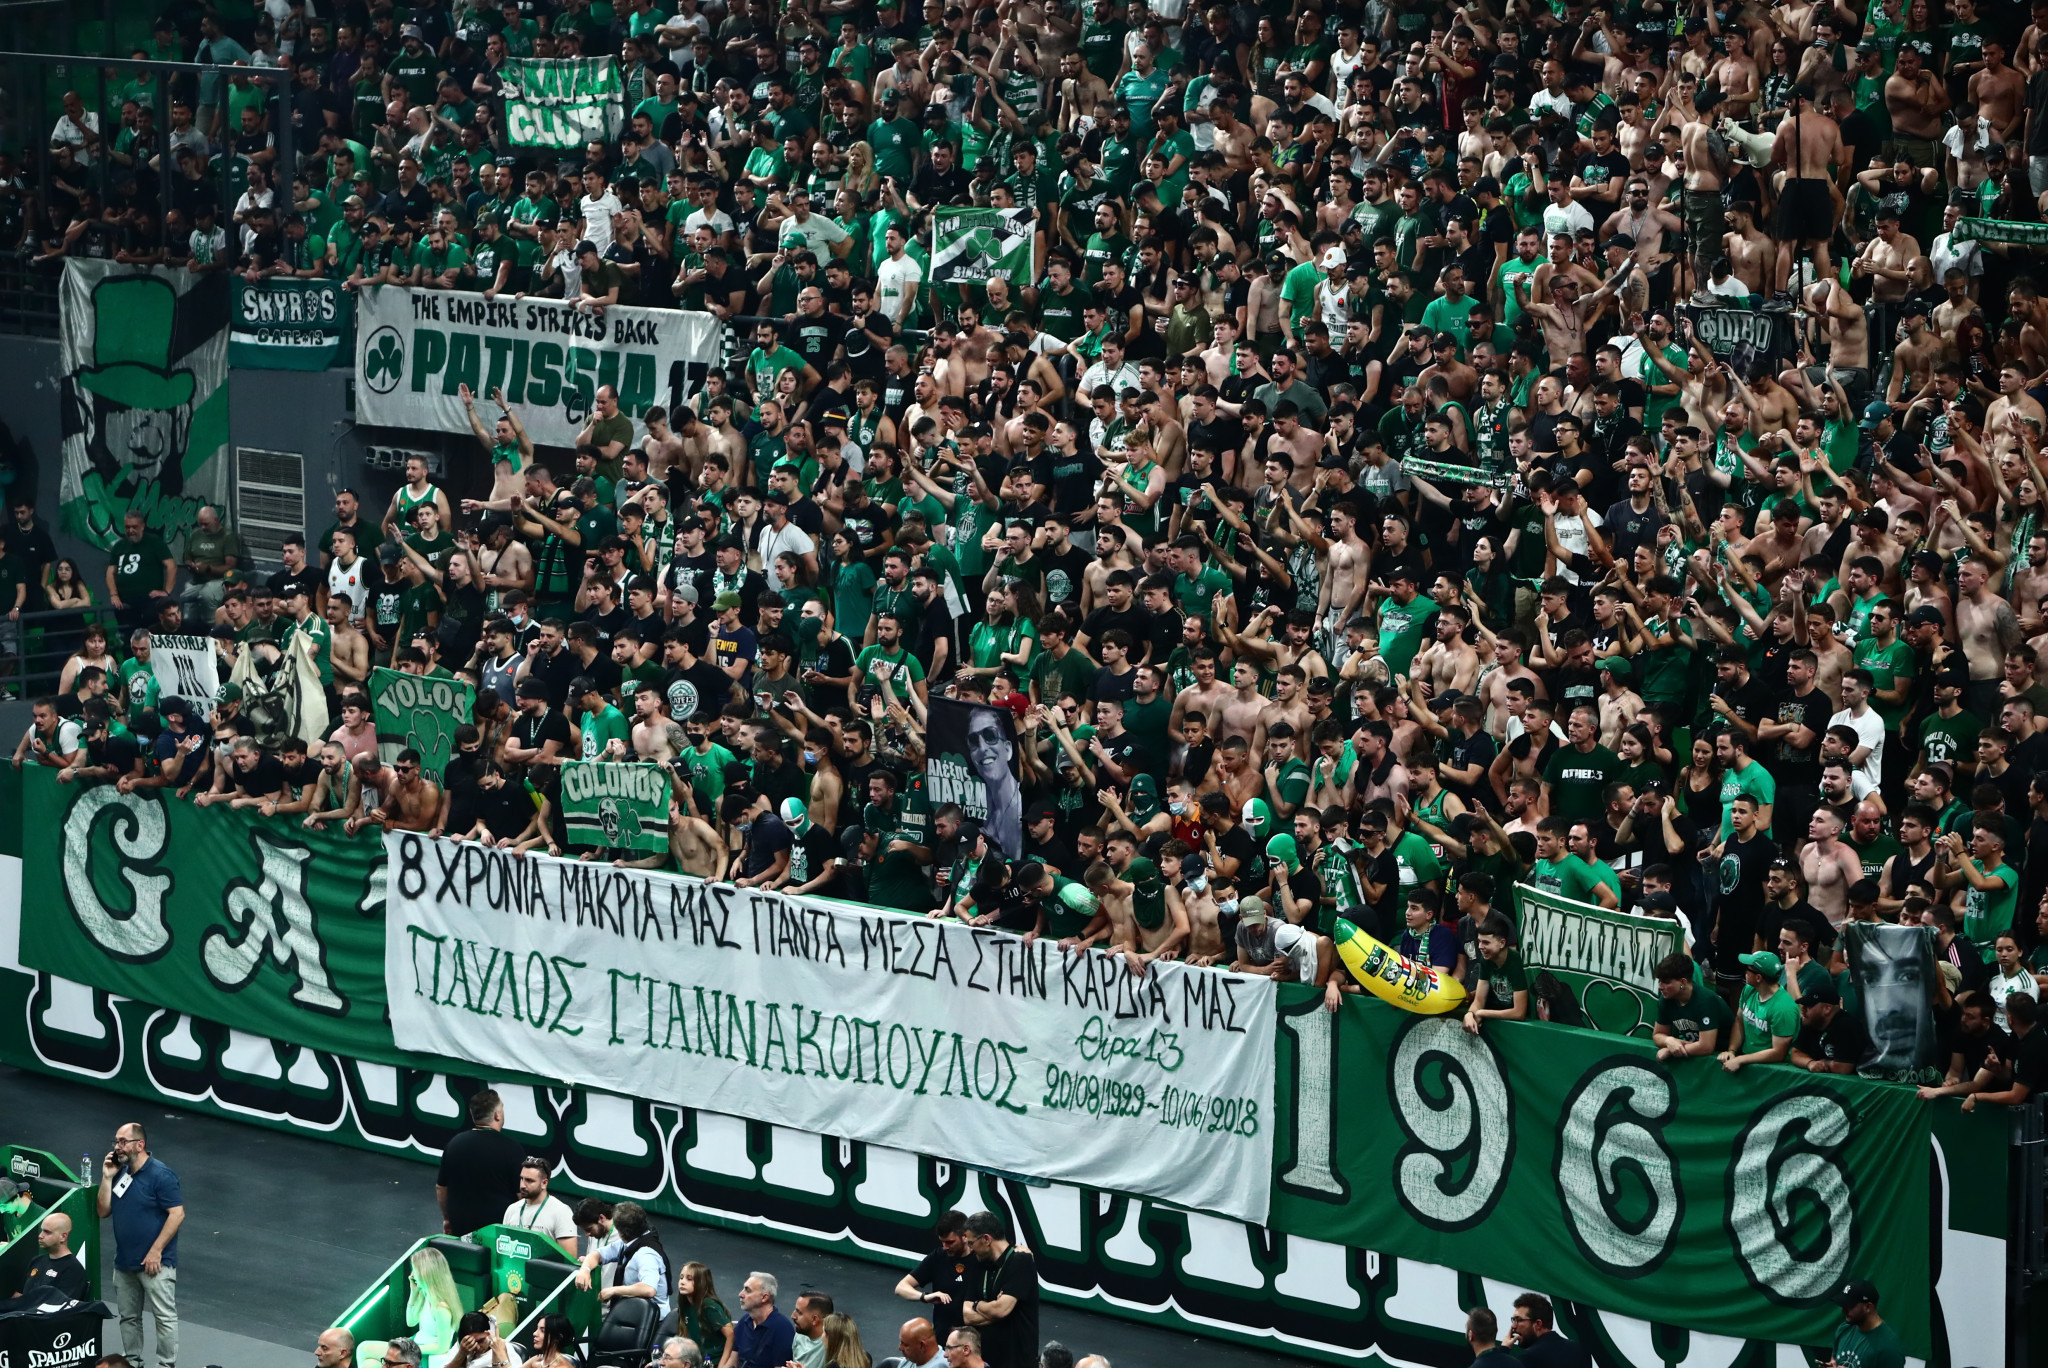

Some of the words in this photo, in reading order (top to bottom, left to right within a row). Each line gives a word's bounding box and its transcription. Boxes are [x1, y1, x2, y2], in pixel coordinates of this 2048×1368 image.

[523, 57, 623, 103] KAVALA
[952, 266, 987, 281] SINCE
[258, 328, 302, 345] GATE
[309, 329, 325, 345] 13
[412, 294, 440, 321] THE
[447, 297, 519, 329] EMPIRE
[526, 304, 607, 341] STRIKES
[614, 318, 659, 346] BACK
[807, 336, 820, 353] 25
[412, 328, 657, 420] PATISSIA
[716, 640, 738, 653] ENVER
[377, 676, 467, 726] VOLOS
[927, 757, 972, 782] Αλέξης
[1928, 743, 1947, 763] 13
[563, 763, 667, 809] COLONOS
[928, 775, 988, 809] ΠΑΡΩΝ
[398, 833, 427, 900] 8
[435, 841, 551, 920] ΧΡΟΝΙΑ
[560, 862, 663, 943] ΜΑΚΡΙΑ
[671, 884, 742, 950] ΜΑΣ
[749, 896, 846, 969] ΠΑΝΤΑ
[860, 915, 958, 987] ΜΕΣΑ
[966, 929, 1047, 1001] ΣΤΗΝ
[1062, 946, 1171, 1024] ΚΑΡΔΙΑ
[1183, 970, 1247, 1034] ΜΑΣ
[406, 924, 587, 1037] ΠΑΥΛΟΣ
[608, 968, 1028, 1115] ΓΙΑΝΝΑΚΟΠΟΥΛΟΣ
[1144, 1027, 1185, 1072] 13
[1160, 1084, 1259, 1139] 10/06/2018
[1278, 1000, 1861, 1306] 1966
[28, 1337, 97, 1368] SPALDING
